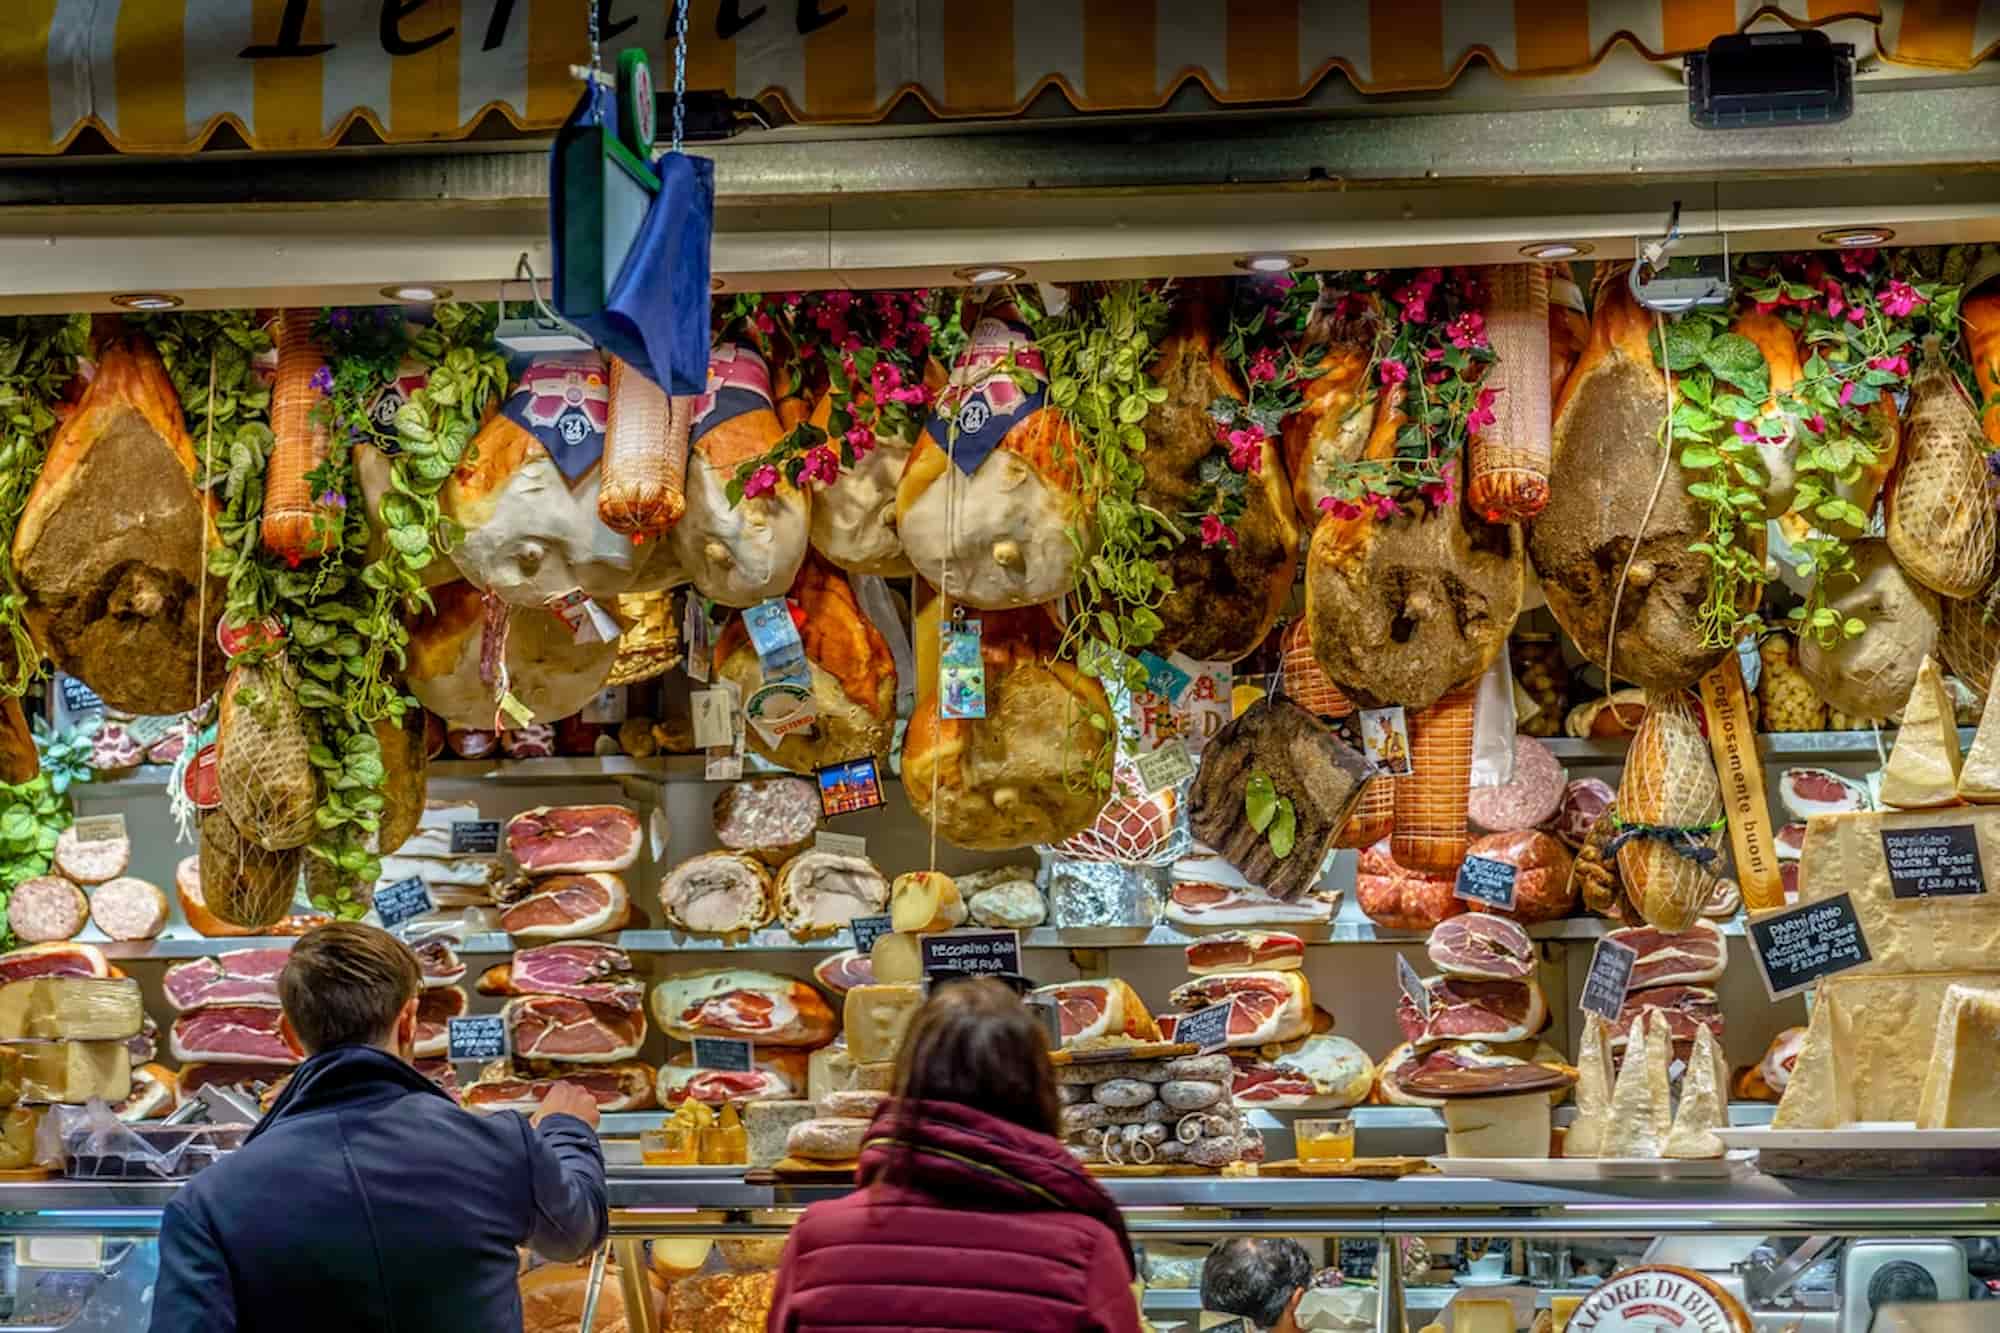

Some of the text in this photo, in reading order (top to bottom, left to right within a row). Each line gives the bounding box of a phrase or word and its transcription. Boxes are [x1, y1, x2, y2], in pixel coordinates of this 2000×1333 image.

[1744, 820, 1768, 873] buoni
[931, 942, 990, 957] PECORINO
[948, 958, 1004, 970] RISERVA
[1656, 1278, 1683, 1302] DI
